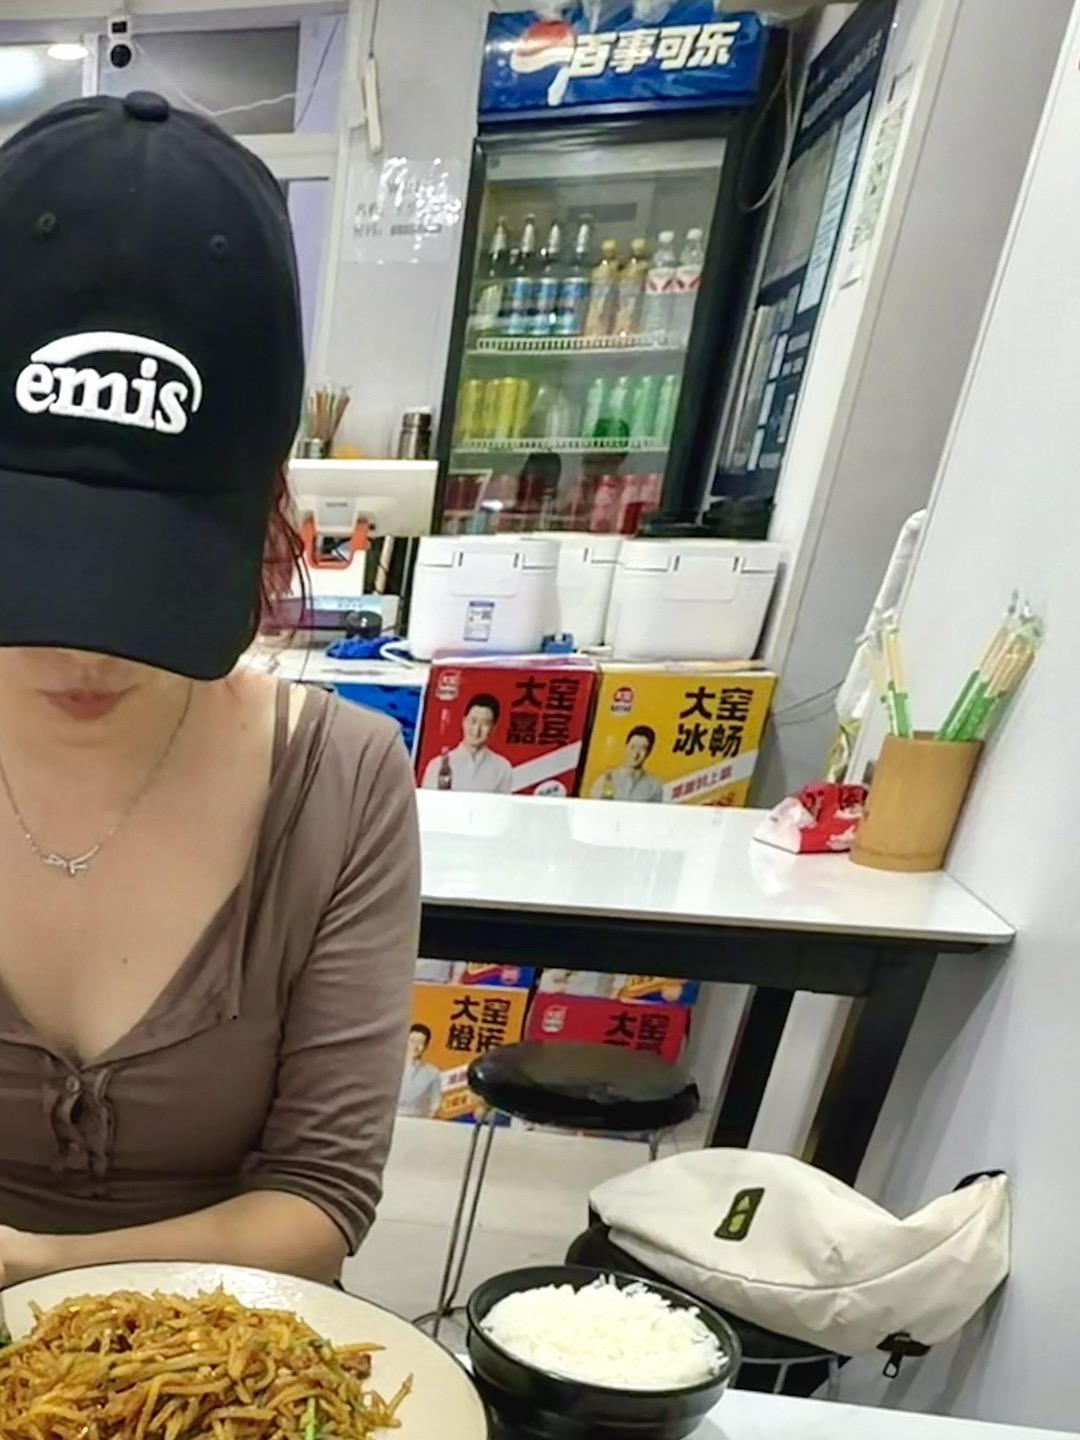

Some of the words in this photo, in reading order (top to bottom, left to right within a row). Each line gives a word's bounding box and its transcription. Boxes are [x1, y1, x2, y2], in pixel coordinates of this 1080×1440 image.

[568, 21, 741, 78] 百事可乐
[15, 357, 189, 435] emis
[510, 675, 581, 711] 大窑
[680, 686, 754, 722] 大窑
[672, 723, 744, 758] 冰畅
[450, 995, 512, 1027] 大窑
